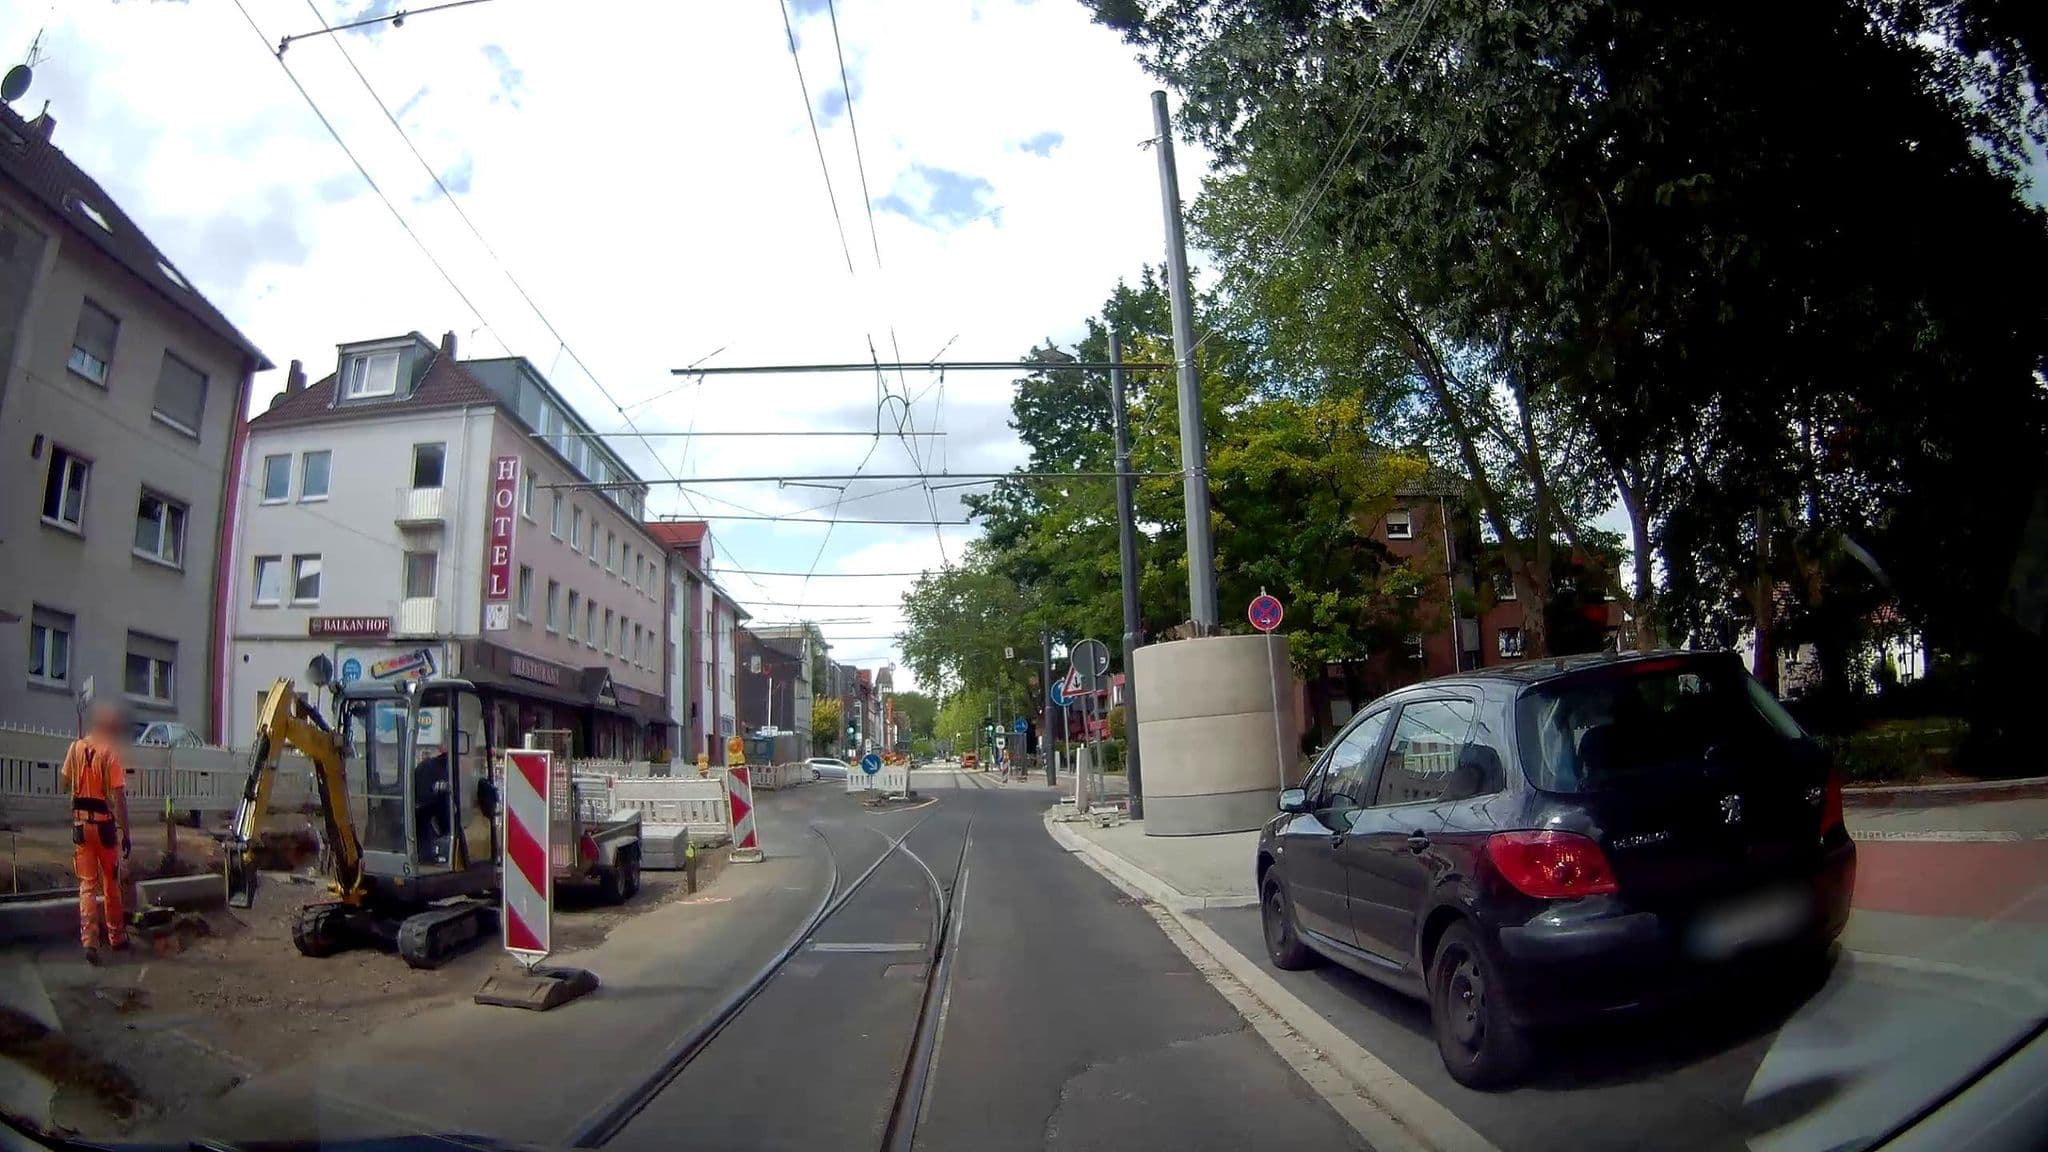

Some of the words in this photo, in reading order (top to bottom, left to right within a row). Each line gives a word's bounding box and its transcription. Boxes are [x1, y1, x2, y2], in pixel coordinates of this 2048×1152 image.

[491, 459, 515, 595] HOTEL
[324, 619, 364, 632] BALKAN
[366, 619, 388, 632] HOF
